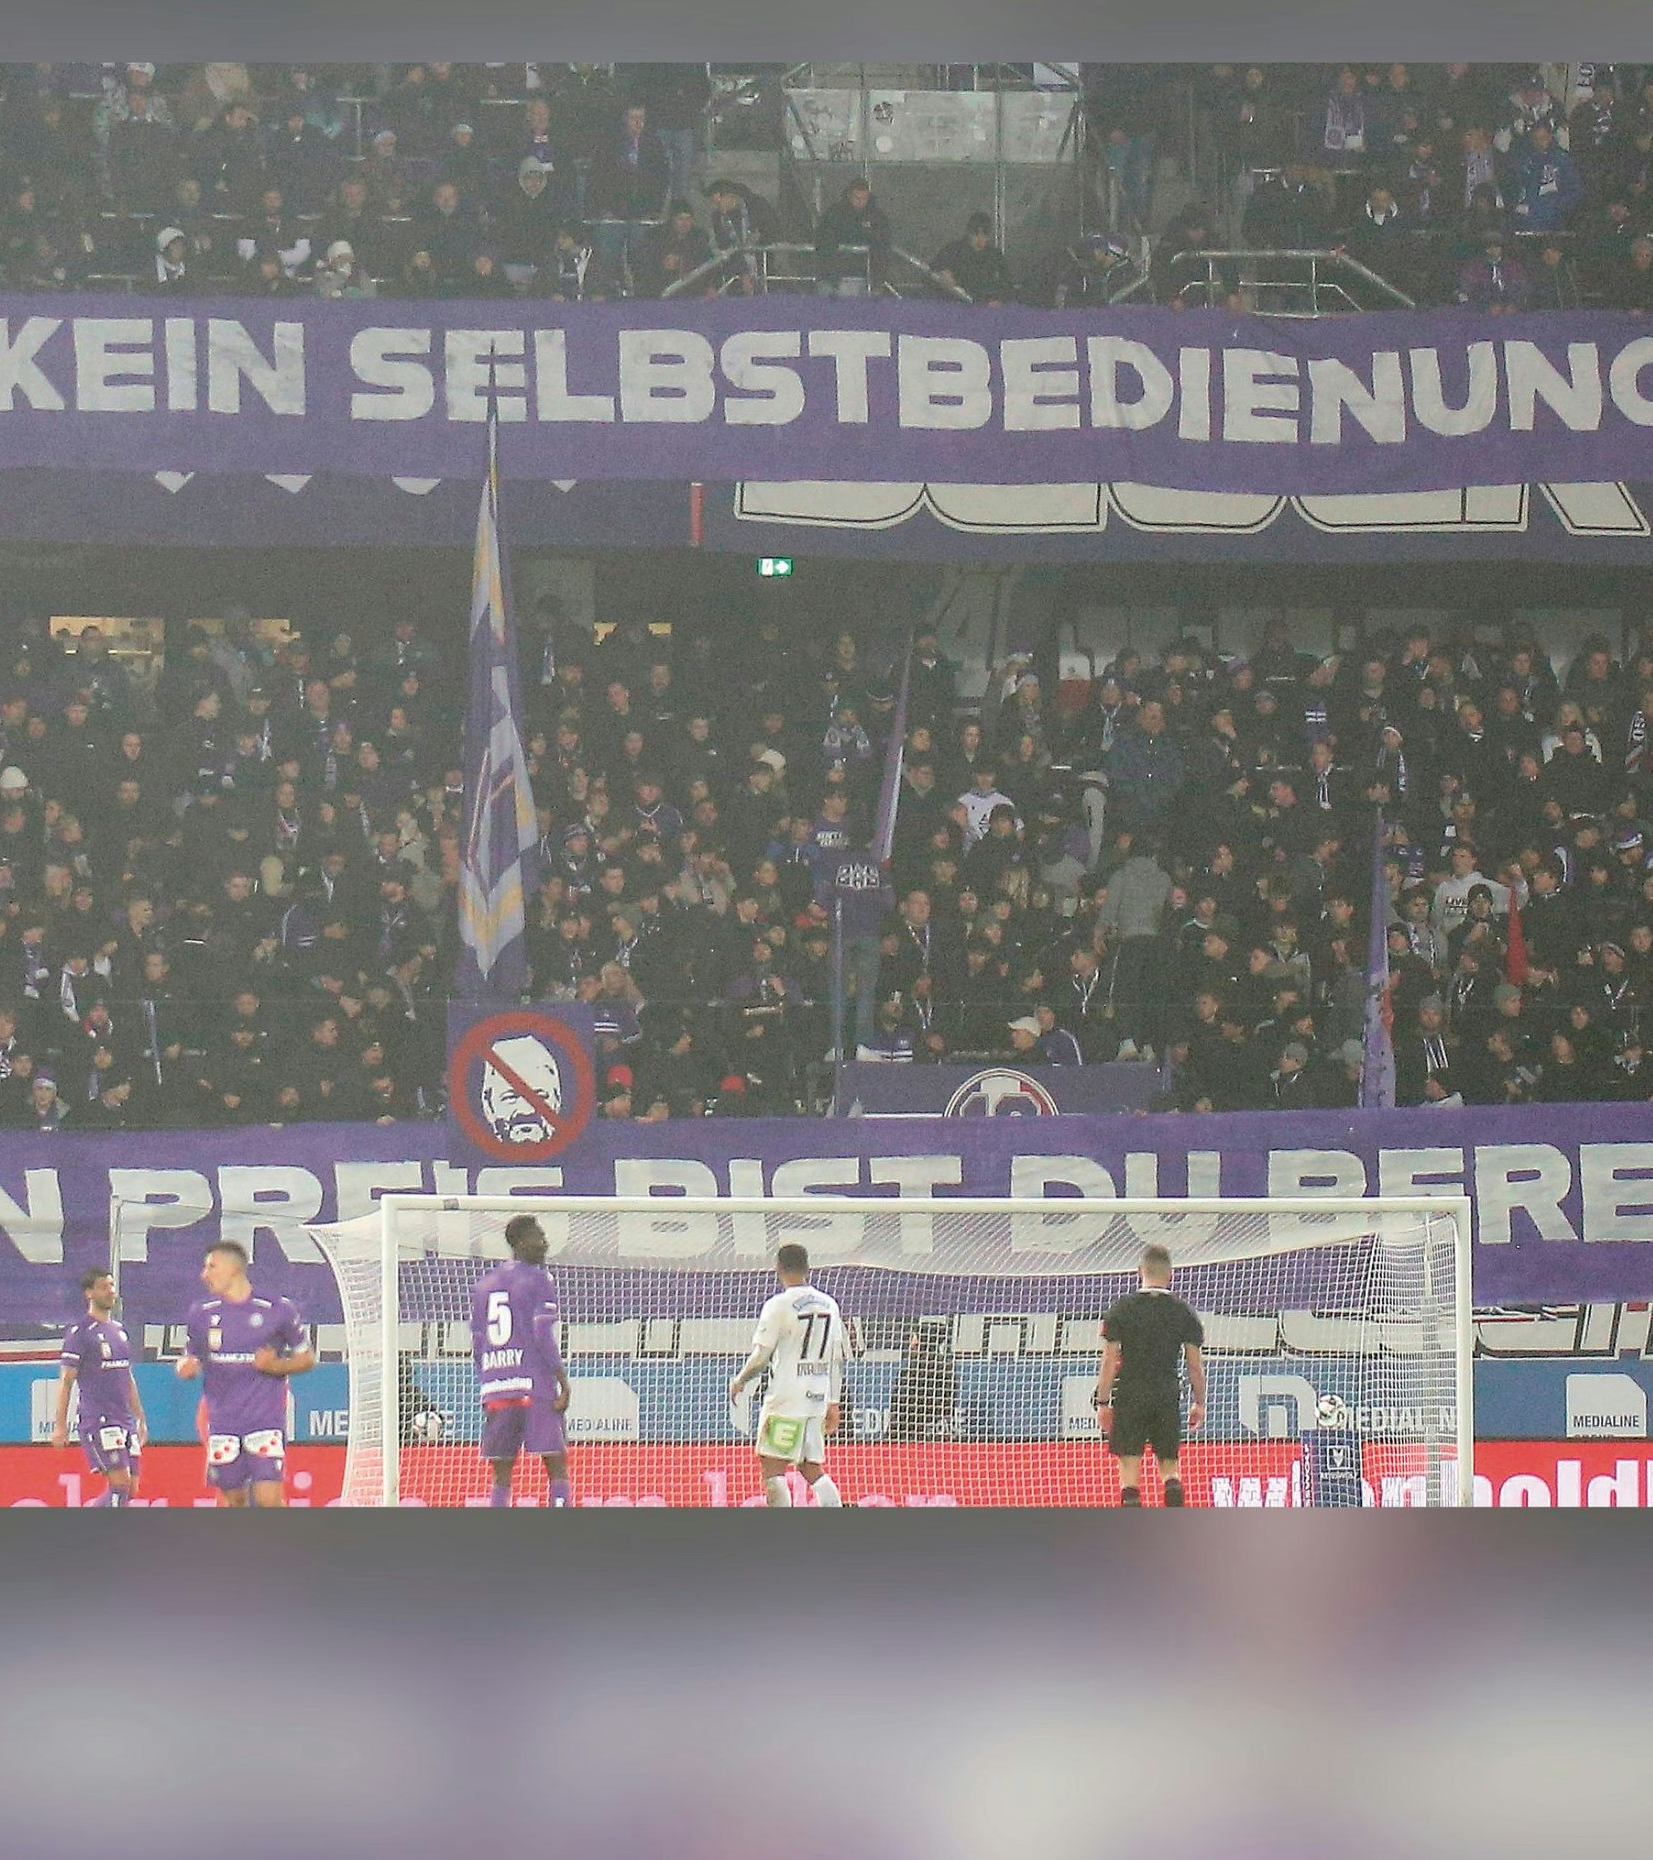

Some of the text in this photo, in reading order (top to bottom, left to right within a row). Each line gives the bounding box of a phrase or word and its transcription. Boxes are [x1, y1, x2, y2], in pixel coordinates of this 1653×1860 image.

[109, 1160, 569, 1264] PREIS
[614, 1154, 963, 1260] BIST
[1011, 1152, 1221, 1257] DU
[488, 1291, 513, 1347] 5
[798, 1314, 832, 1360] 77
[482, 1348, 524, 1371] BARRY
[1572, 1414, 1640, 1428] MEDIALINE
